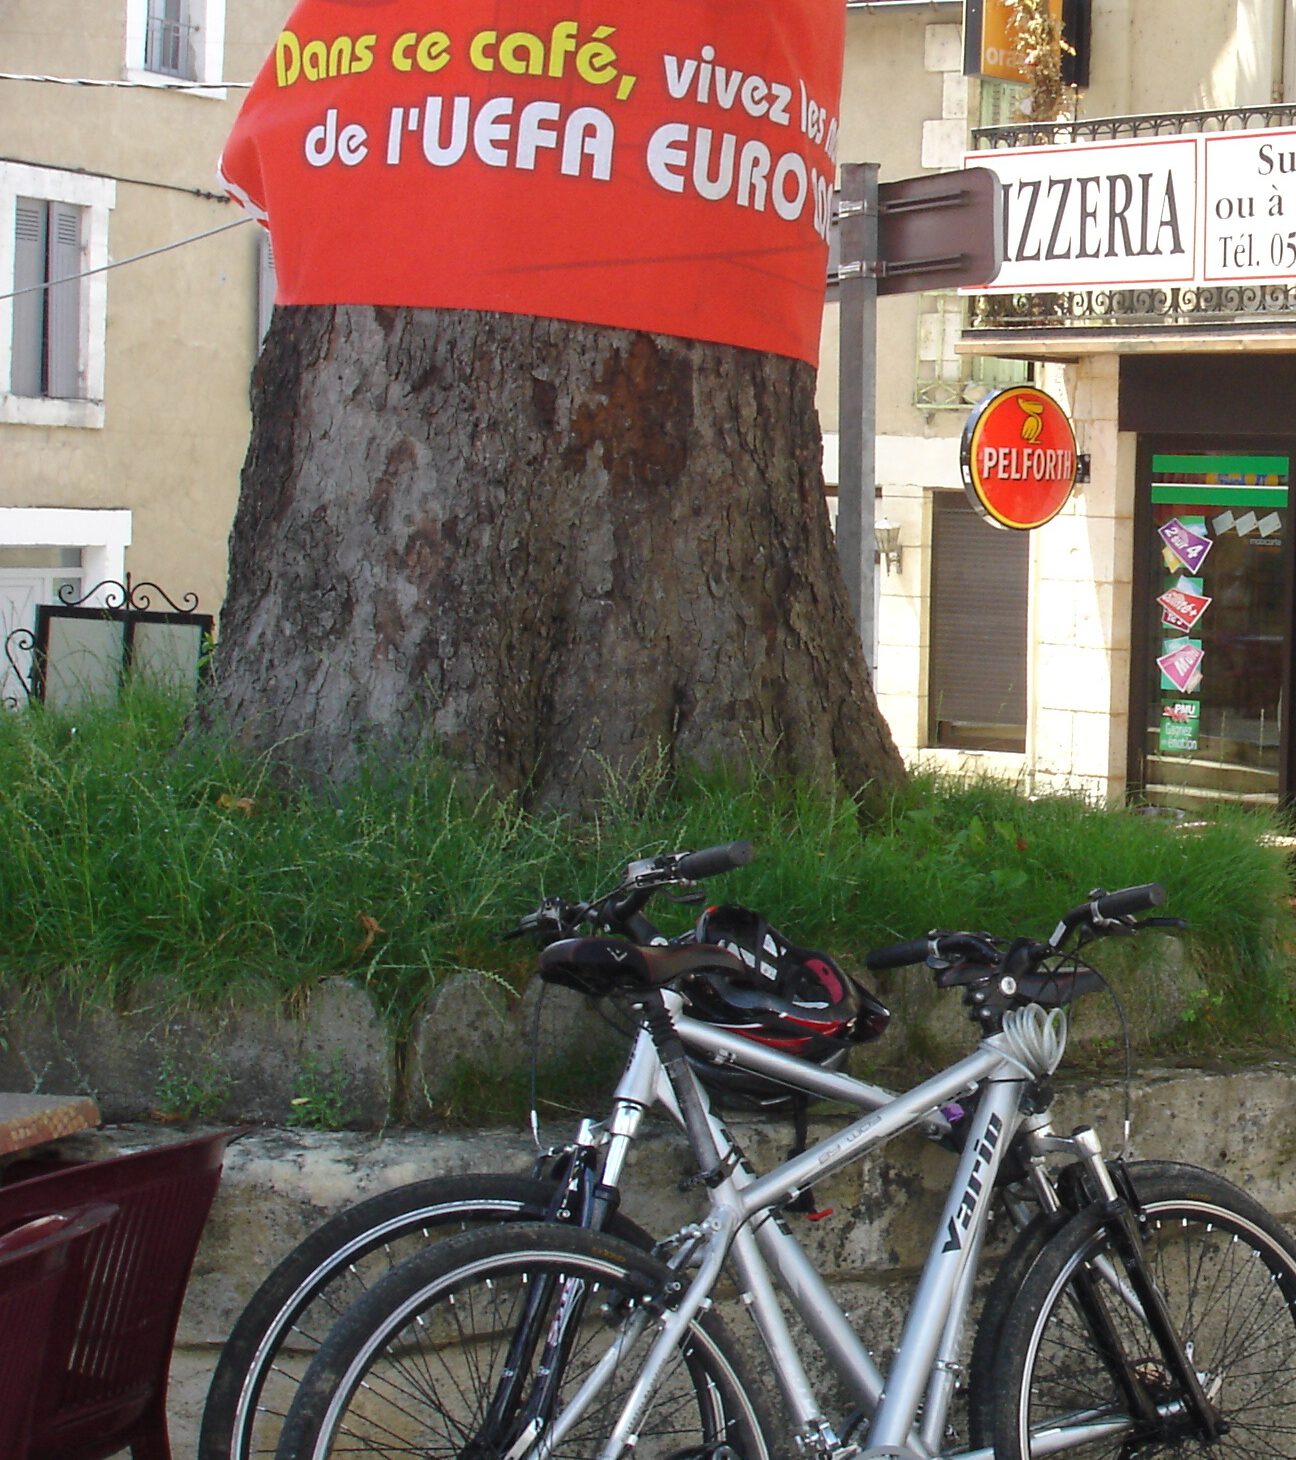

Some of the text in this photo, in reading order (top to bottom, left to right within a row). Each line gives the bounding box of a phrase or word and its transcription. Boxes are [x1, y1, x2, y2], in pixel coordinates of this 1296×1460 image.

[275, 29, 377, 88] Dans
[392, 31, 451, 72] ce
[469, 21, 637, 100] café,
[663, 45, 792, 124] vivez
[800, 80, 827, 145] les
[305, 108, 368, 167] de
[386, 95, 615, 181] l'UEFA
[646, 122, 808, 222] EURO
[1000, 169, 1186, 264] IZZERIA
[1215, 195, 1256, 221] ou
[1268, 186, 1285, 218] à
[1218, 232, 1262, 269] Tél.
[983, 447, 1073, 481] PELFORTH
[1186, 544, 1204, 559] 4
